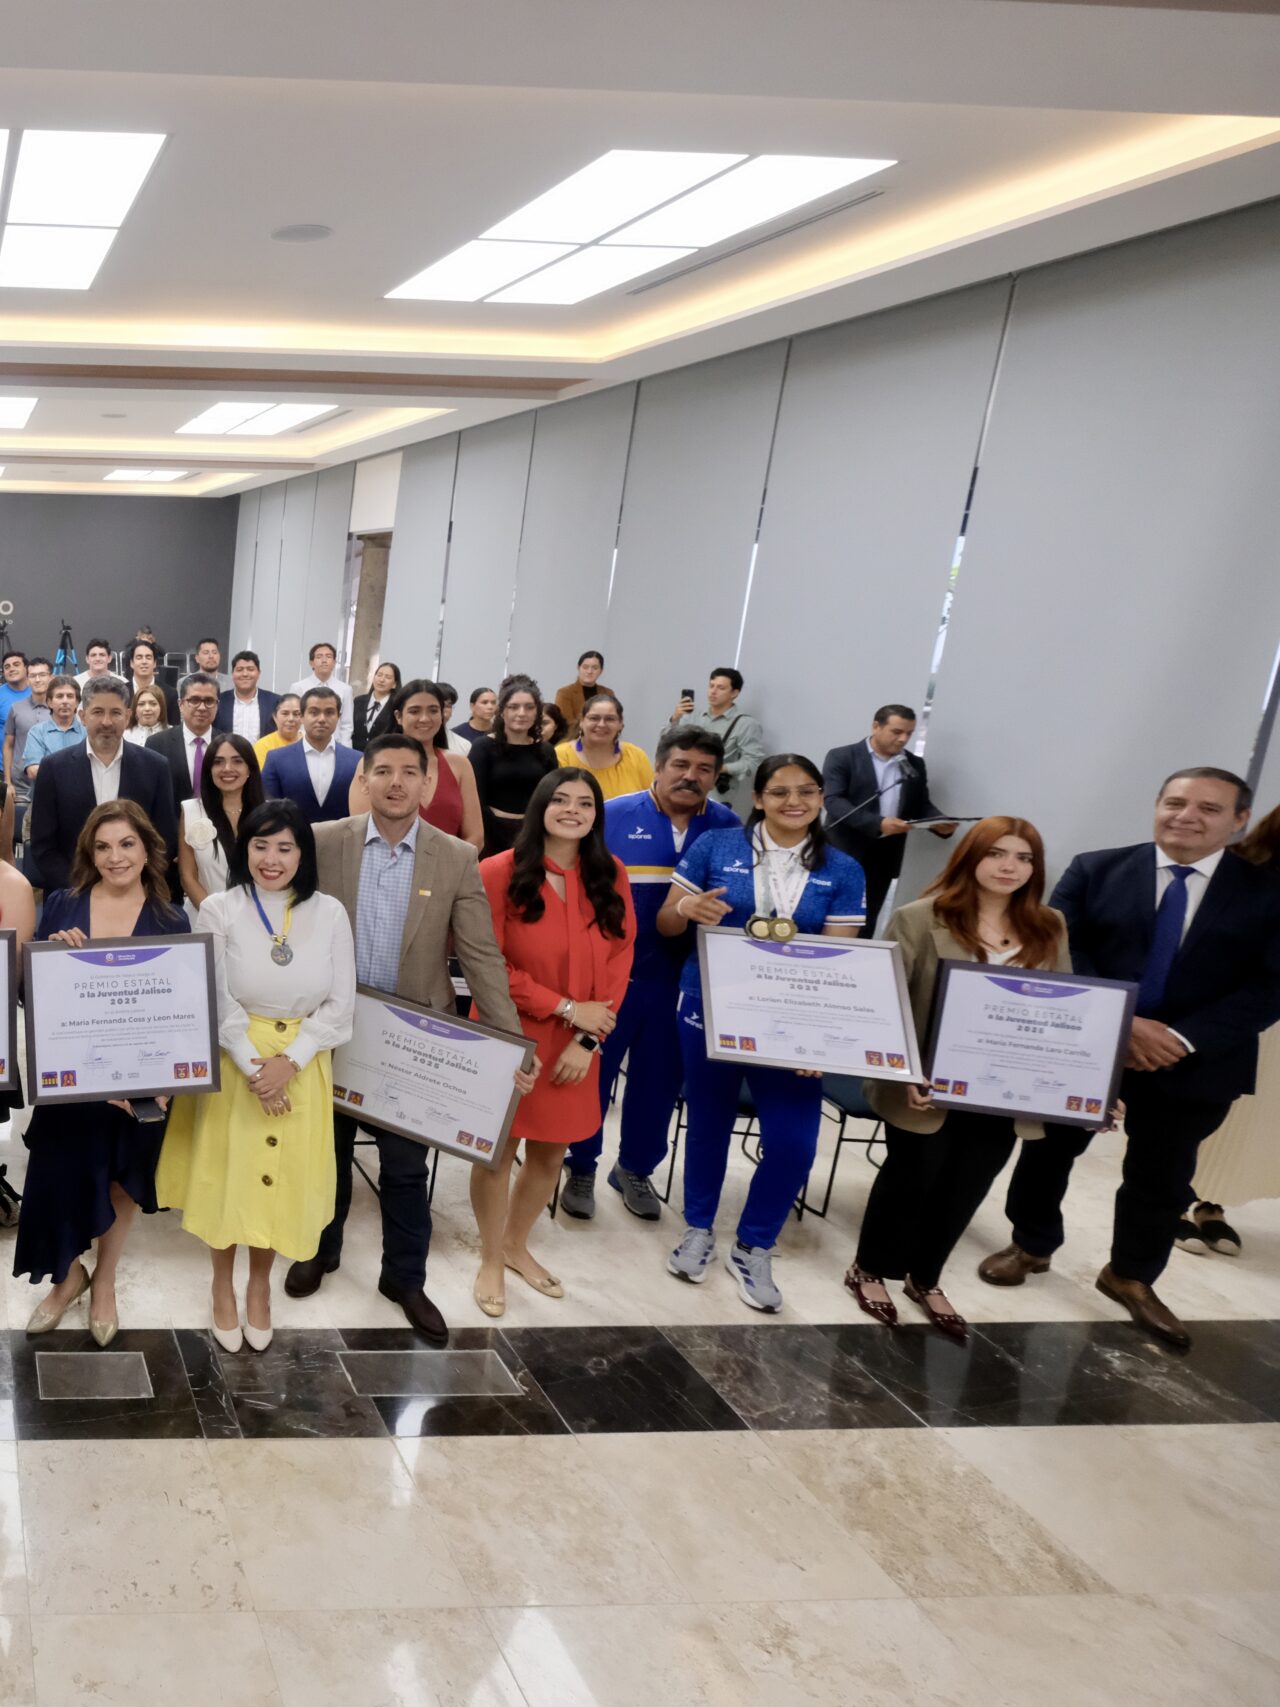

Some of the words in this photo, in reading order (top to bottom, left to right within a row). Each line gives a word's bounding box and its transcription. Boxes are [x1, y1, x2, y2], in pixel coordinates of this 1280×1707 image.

[750, 964, 797, 976] PREMIO
[803, 969, 856, 981] ESTATAL
[74, 980, 119, 990] PREMIO
[124, 978, 172, 988] ESTATAL
[775, 975, 821, 985] Juventud
[822, 979, 857, 988] Jalisco
[789, 983, 819, 991] 2025
[87, 990, 96, 998] la
[97, 987, 139, 997] Juventud
[140, 986, 172, 995] Jalisco
[110, 997, 137, 1005] 2025
[983, 1003, 1029, 1016] PREMIO
[1035, 1008, 1083, 1023] ESTATAL
[91, 1016, 126, 1025] Fernanda
[382, 1030, 426, 1049] PREMIO
[431, 1046, 479, 1069] ESTATAL
[401, 1044, 444, 1063] Juventud
[445, 1060, 478, 1075] Jalisco
[413, 1056, 440, 1069] 2025
